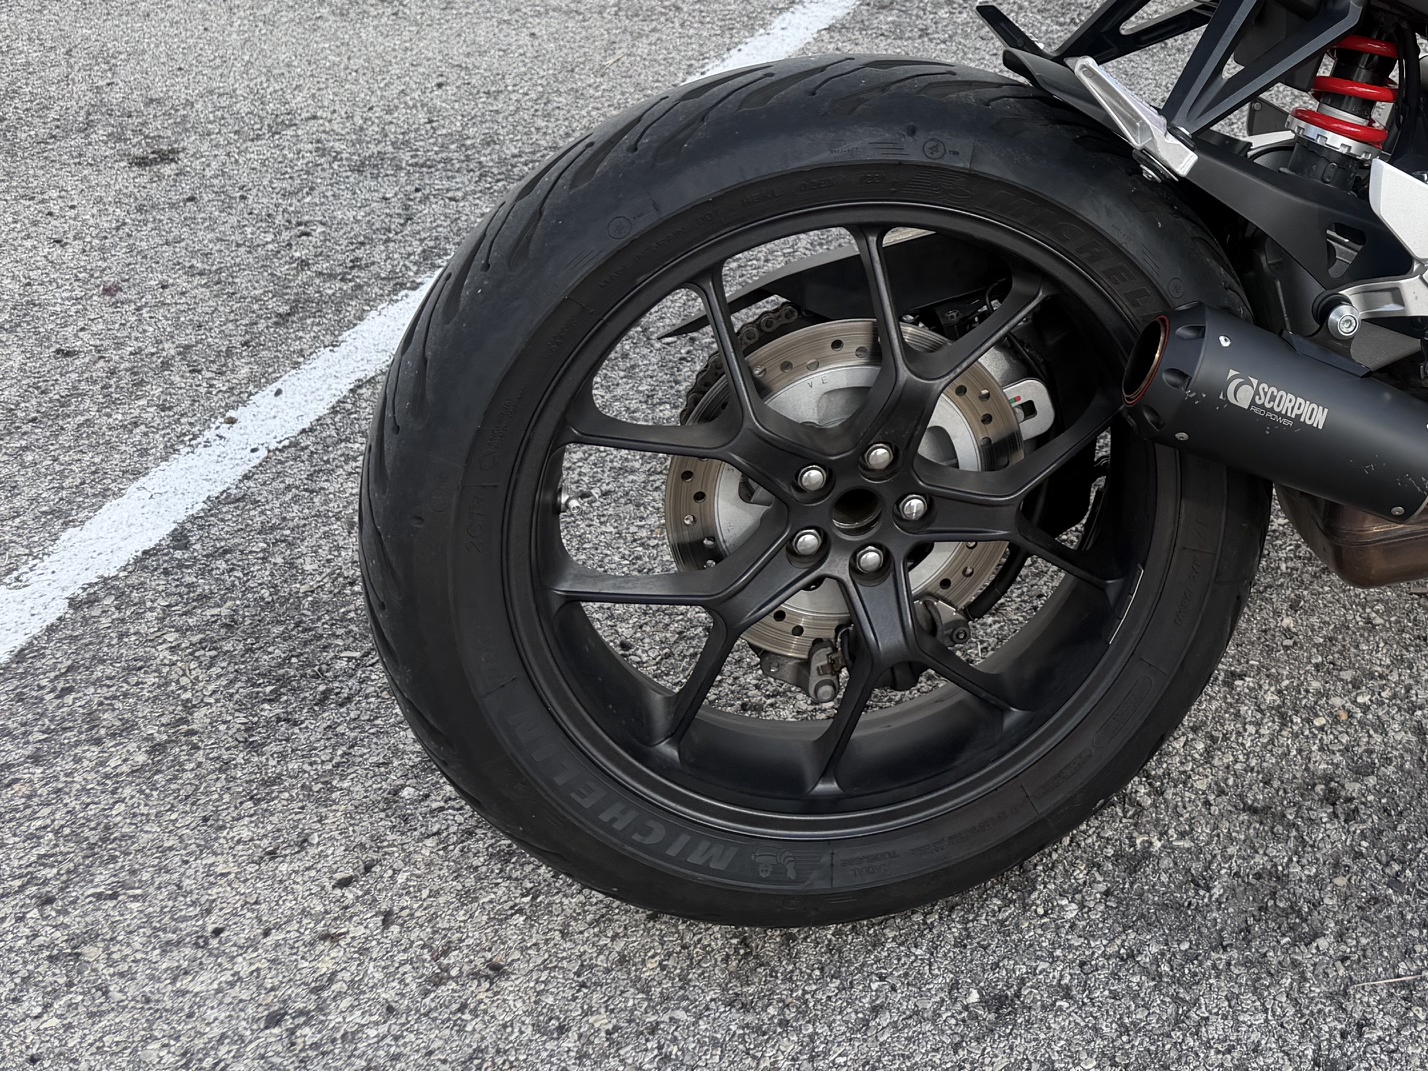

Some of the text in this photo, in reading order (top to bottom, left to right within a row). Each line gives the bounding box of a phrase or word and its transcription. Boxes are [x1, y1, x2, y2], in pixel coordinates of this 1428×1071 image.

[1250, 405, 1293, 427] RED POWER
[1255, 383, 1328, 429] SCORPION
[504, 706, 737, 873] MICHELIN
